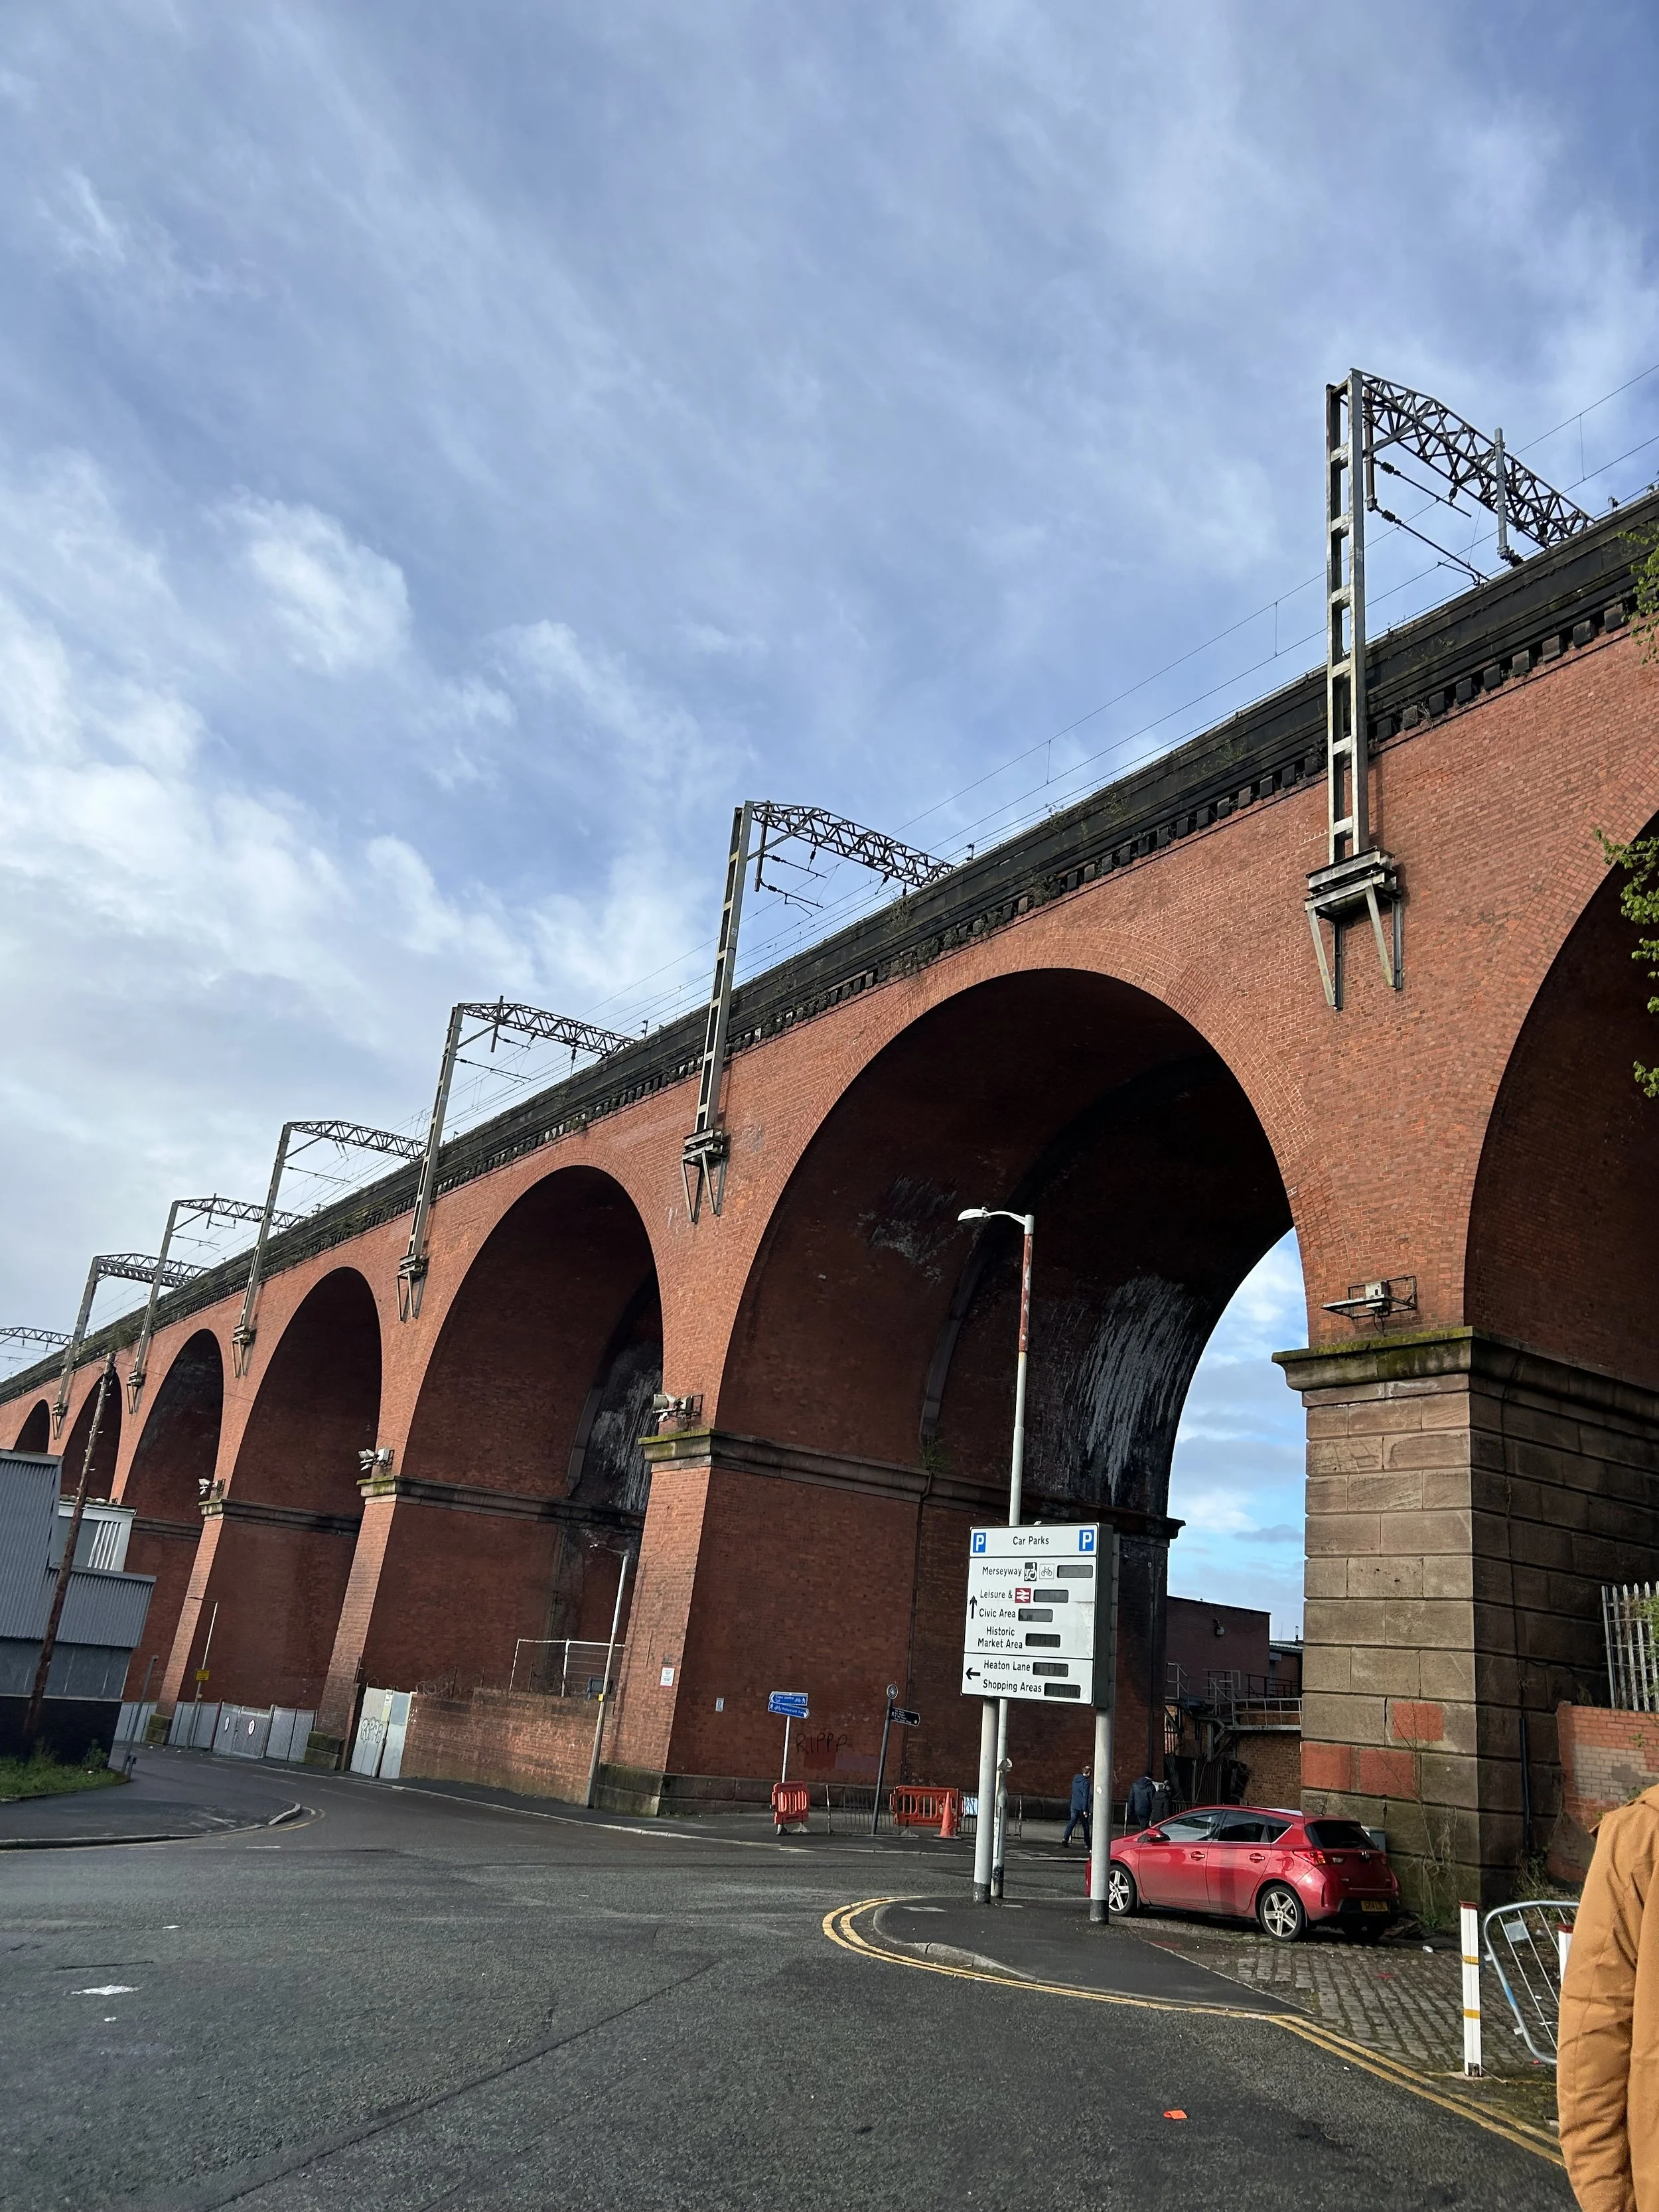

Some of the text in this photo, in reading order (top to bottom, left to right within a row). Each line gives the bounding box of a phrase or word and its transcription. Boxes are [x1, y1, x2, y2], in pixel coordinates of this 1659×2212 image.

[975, 1534, 985, 1552] P
[1013, 1535, 1050, 1546] Car Parks
[1082, 1531, 1092, 1550] P
[982, 1566, 1023, 1577] Merseyway
[979, 1589, 1013, 1599] Leisure &
[979, 1607, 1016, 1618] Civic Area
[986, 1625, 1015, 1636] Historic
[977, 1637, 1023, 1649] Market Area
[983, 1659, 1031, 1672] Heaton Lane
[982, 1678, 1042, 1692] Shopping Areas
